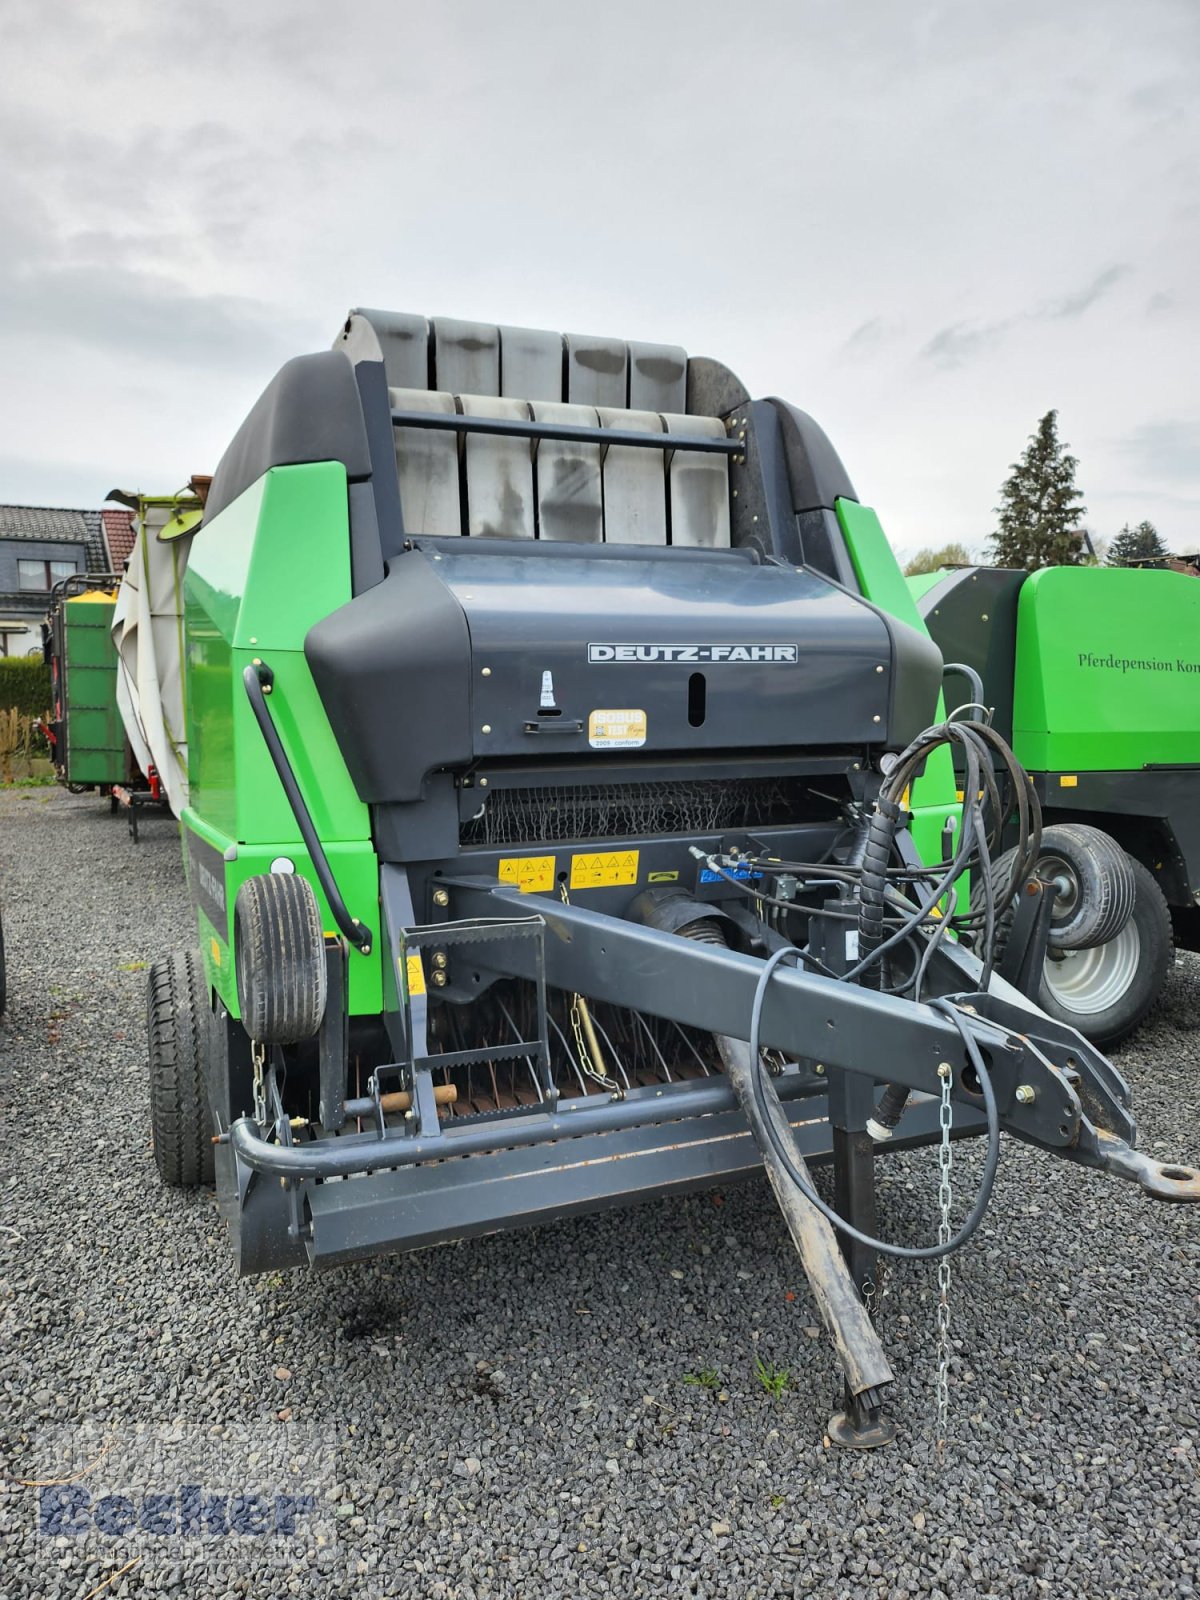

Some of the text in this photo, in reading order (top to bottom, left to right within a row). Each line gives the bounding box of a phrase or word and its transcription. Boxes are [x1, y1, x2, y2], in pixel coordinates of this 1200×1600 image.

[590, 646, 796, 661] DEUTZ-FAHR
[1078, 653, 1173, 673] Pferdepension
[593, 712, 643, 724] ISOBUS
